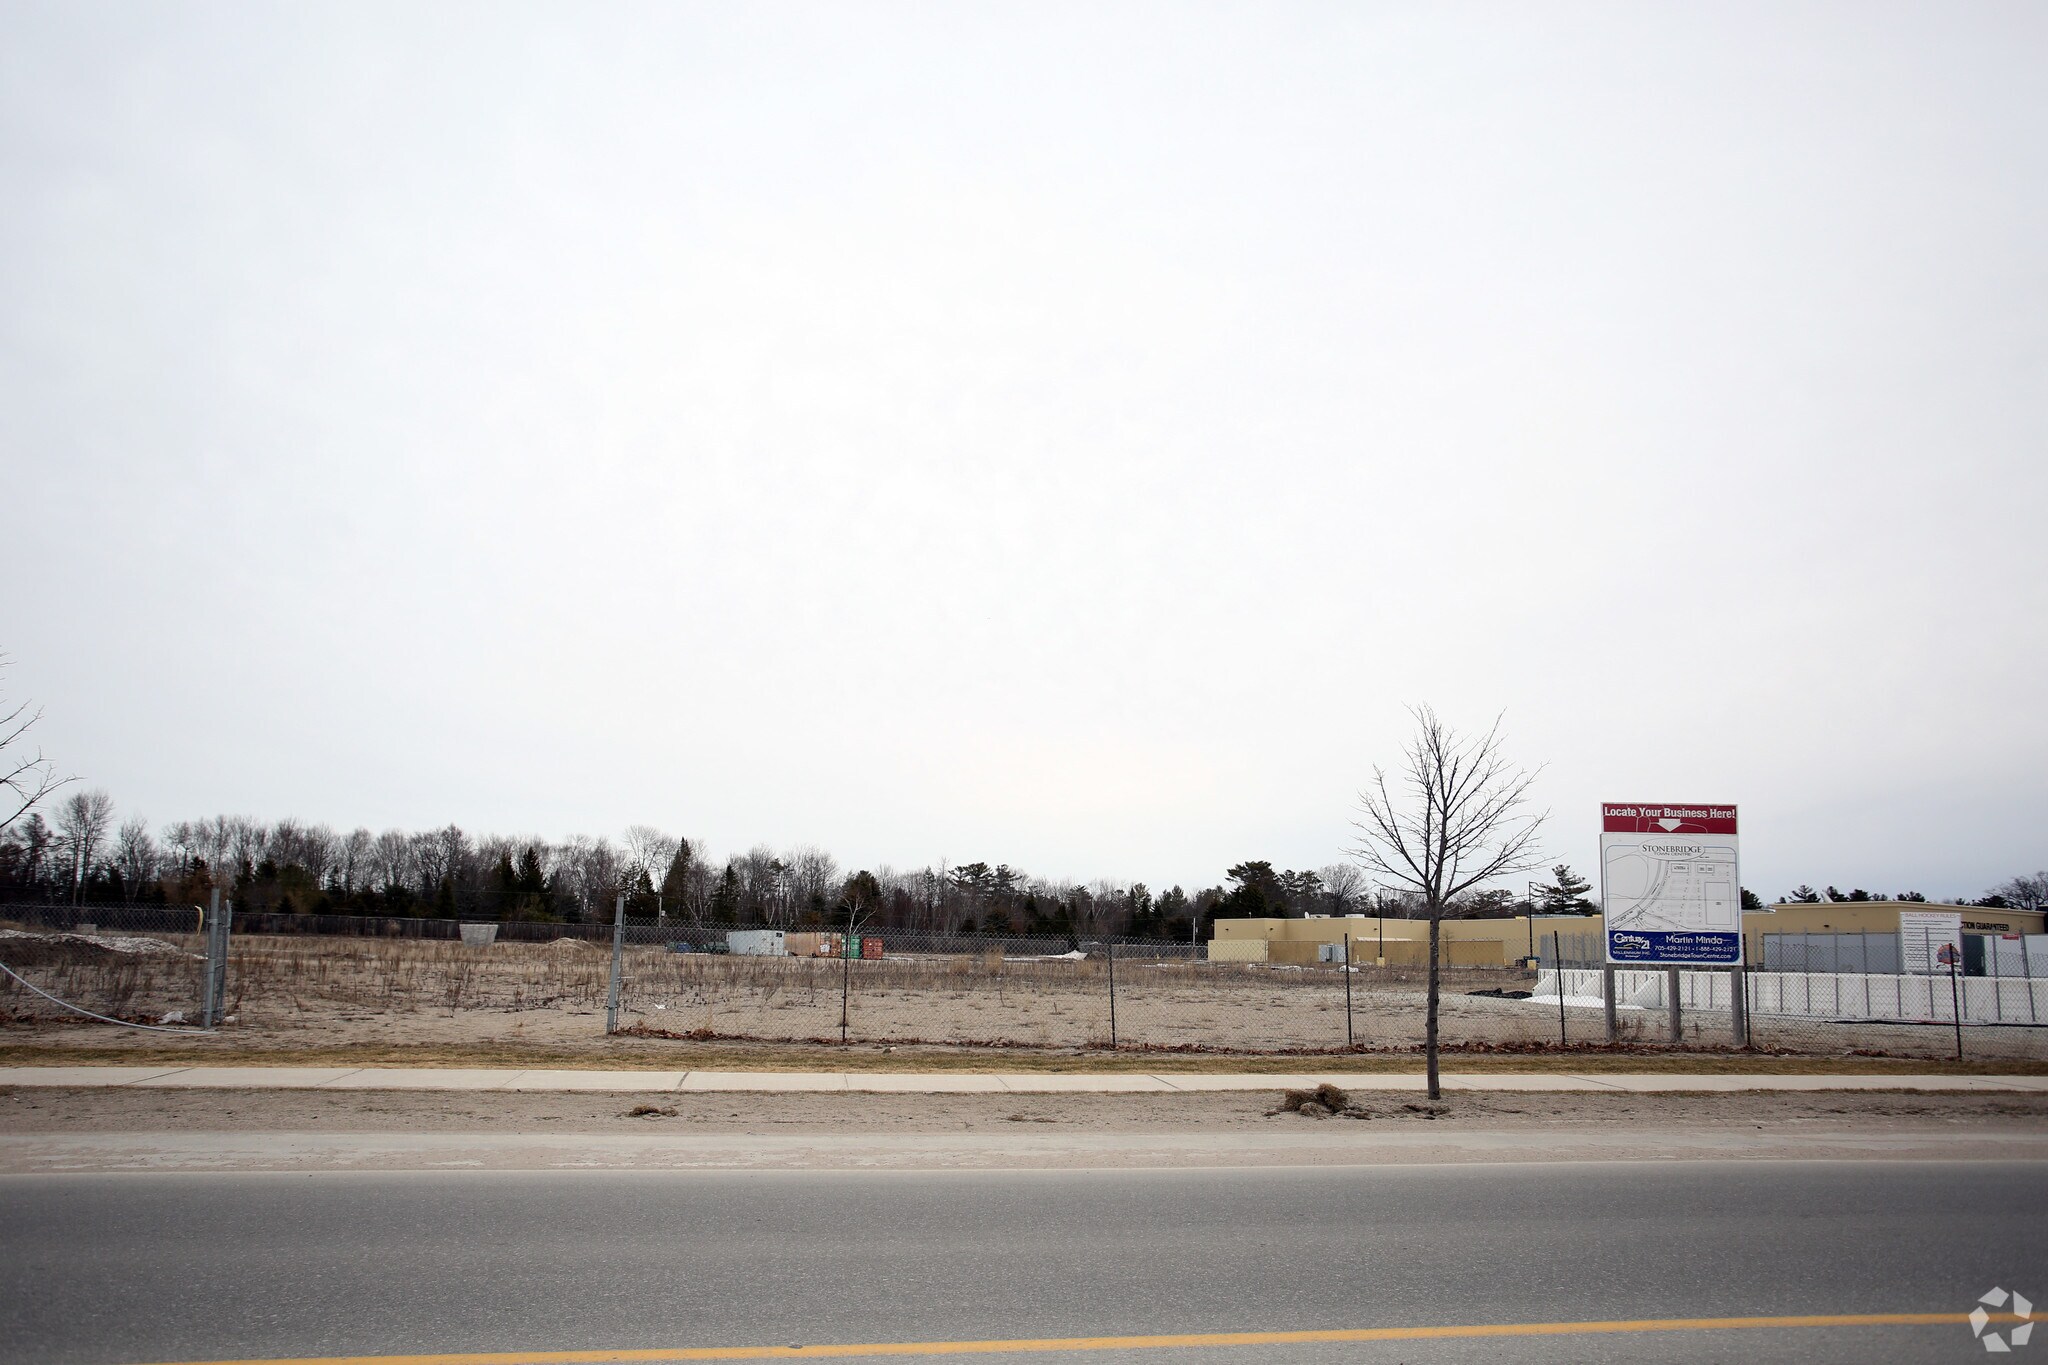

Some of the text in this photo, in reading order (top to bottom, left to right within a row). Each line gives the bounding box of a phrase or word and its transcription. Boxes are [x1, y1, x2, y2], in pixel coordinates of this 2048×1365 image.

[1604, 806, 1736, 819] Locate Your Business Here!
[1642, 844, 1702, 853] STONEBRIDGE
[1976, 922, 2009, 931] GUARANTEED
[1614, 933, 1650, 950] Century 21
[1665, 935, 1723, 945] Martin Minda
